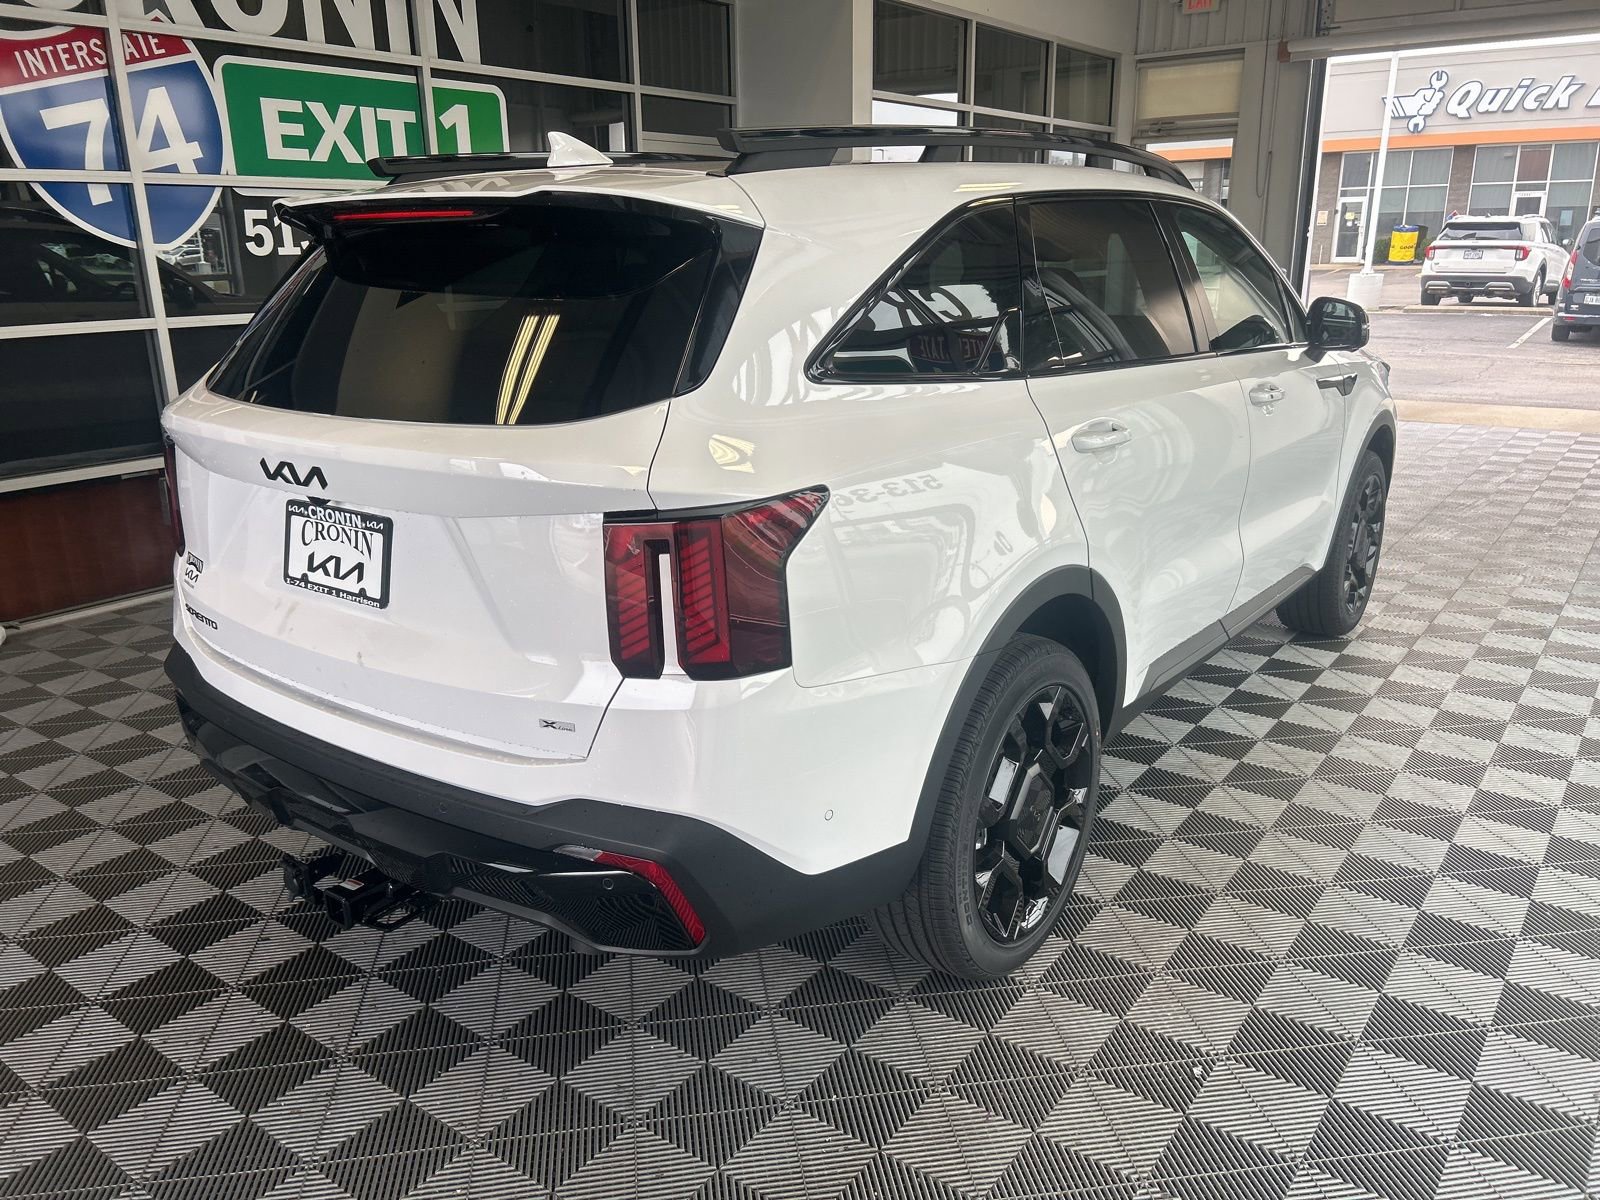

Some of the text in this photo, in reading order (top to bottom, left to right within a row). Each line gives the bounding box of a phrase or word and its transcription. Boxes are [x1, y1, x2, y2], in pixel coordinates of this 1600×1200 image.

[14, 33, 166, 78] INTERSATE
[1446, 76, 1586, 119] Quick
[39, 87, 204, 206] 74
[259, 96, 472, 164] EXIT 1
[243, 209, 310, 257] 51
[259, 457, 328, 490] KIA
[307, 505, 362, 528] CRONIN
[301, 519, 373, 561] CRONIN
[306, 551, 365, 585] KIA
[286, 577, 380, 608] I-74 EXIT 1 Harrison
